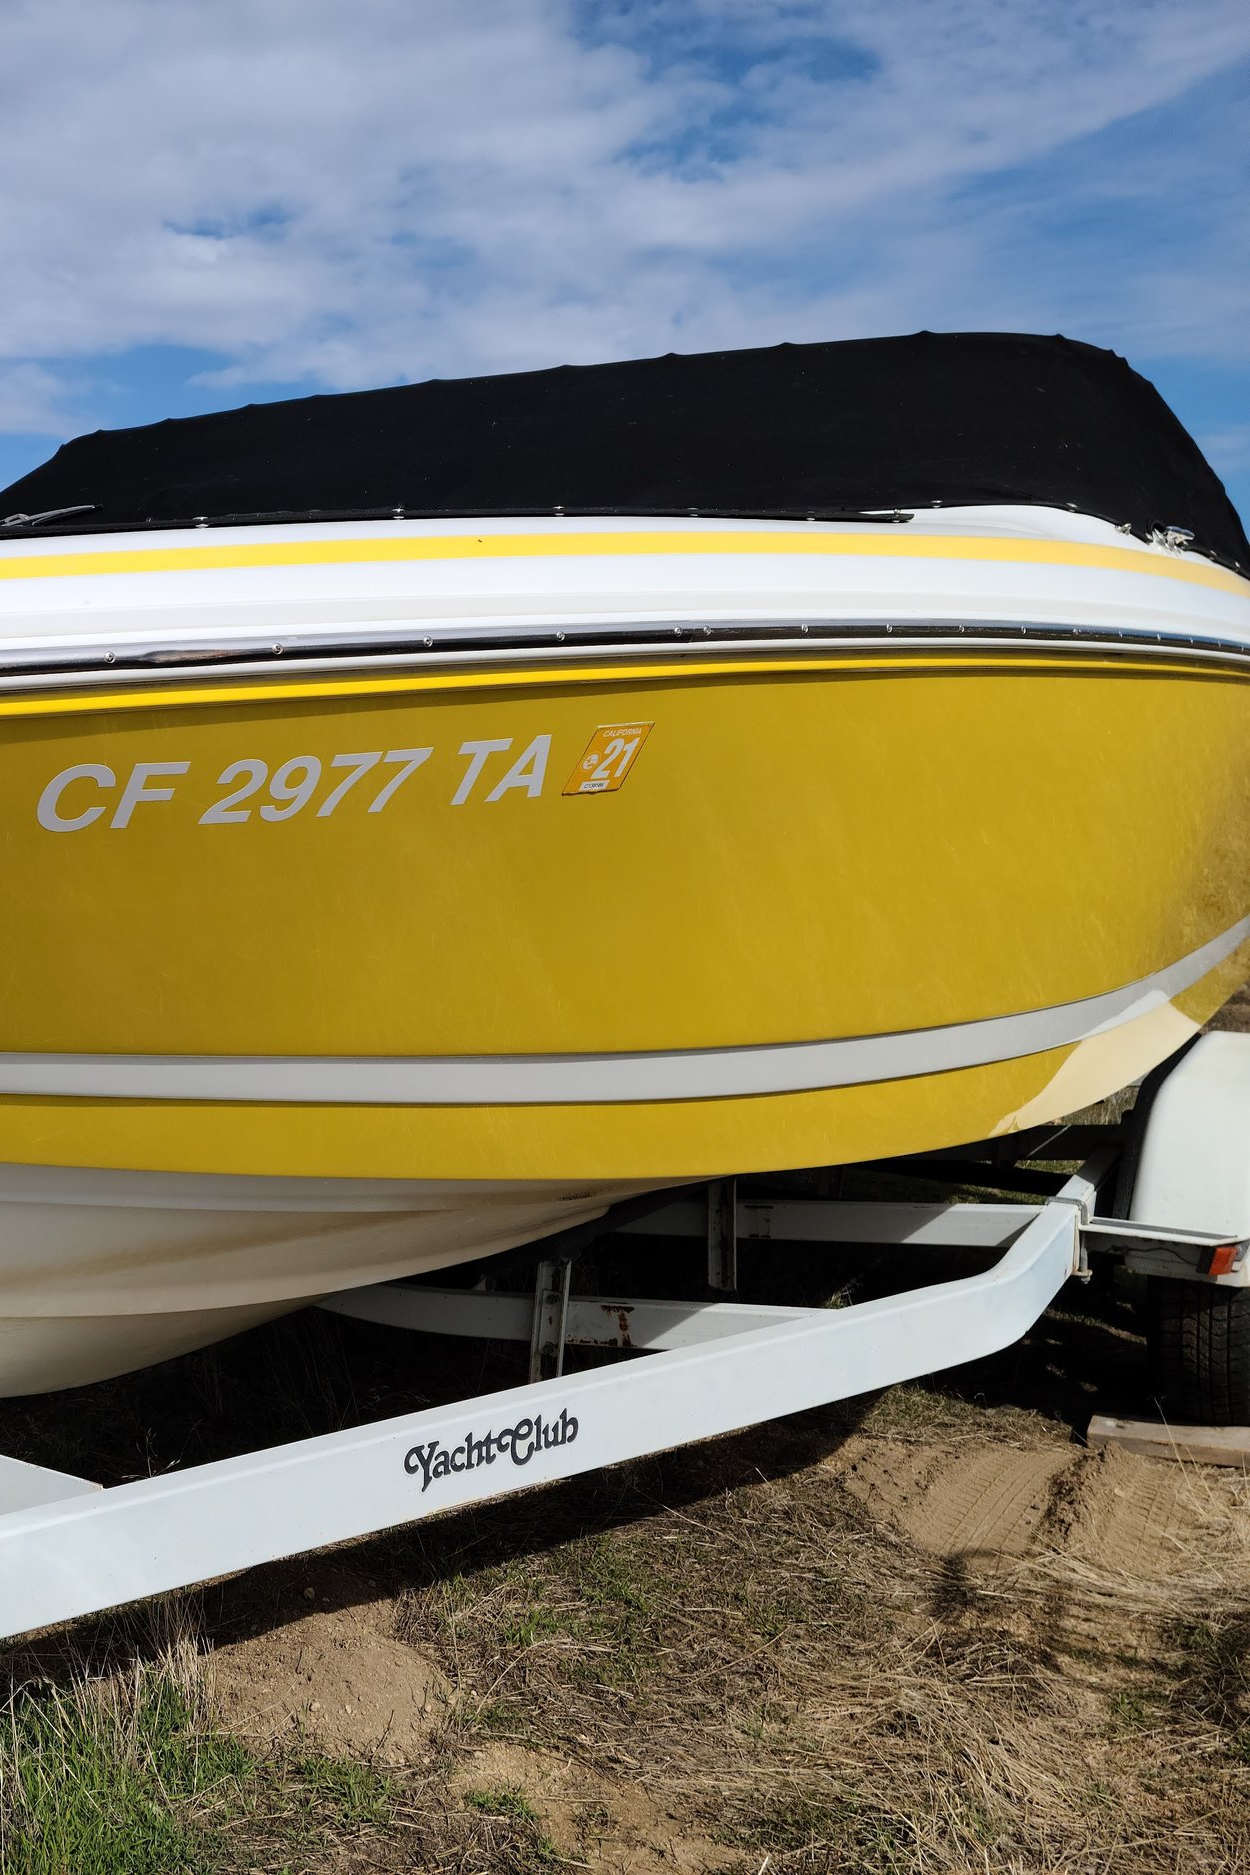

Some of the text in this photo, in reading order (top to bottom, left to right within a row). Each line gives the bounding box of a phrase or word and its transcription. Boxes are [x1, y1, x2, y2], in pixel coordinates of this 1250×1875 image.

[590, 737, 641, 779] 21
[602, 728, 643, 738] CALIFORNIA
[36, 734, 552, 833] CF 2977 TA
[403, 1407, 579, 1493] Yacht Club
